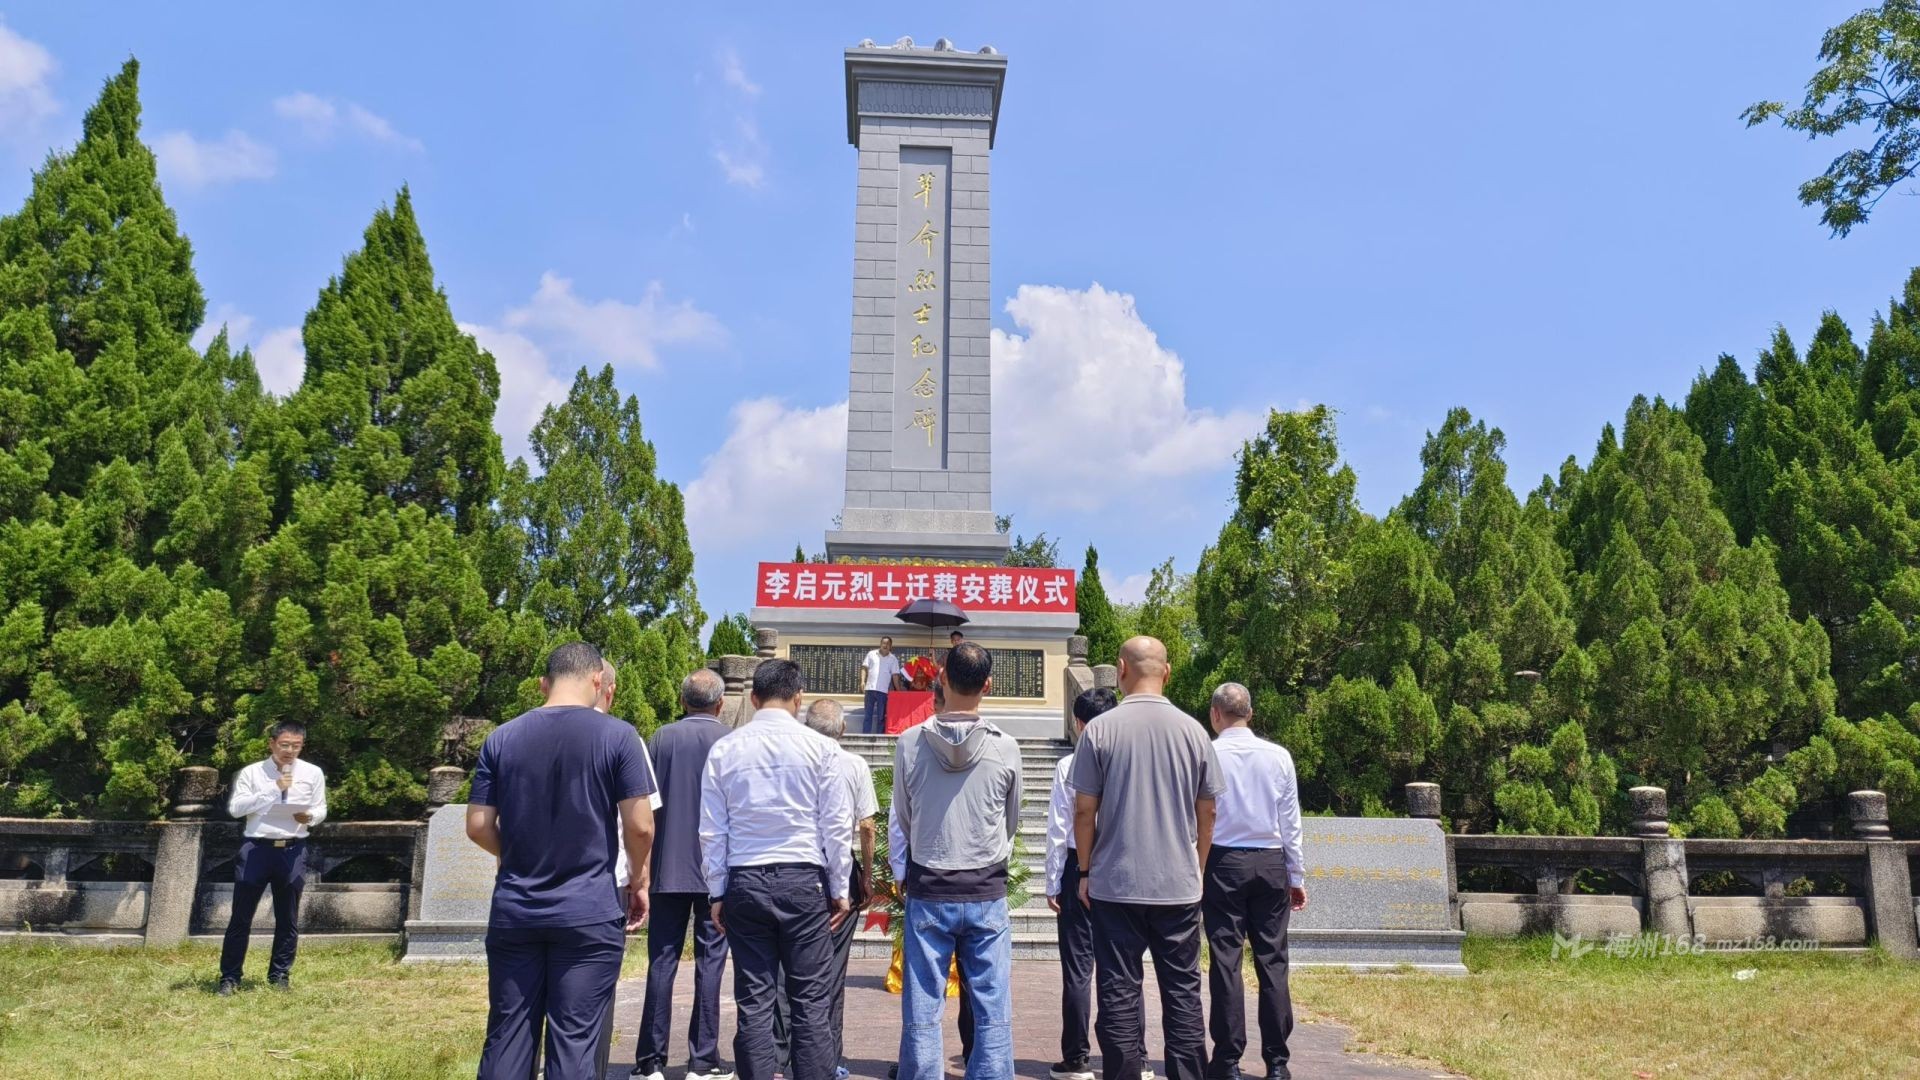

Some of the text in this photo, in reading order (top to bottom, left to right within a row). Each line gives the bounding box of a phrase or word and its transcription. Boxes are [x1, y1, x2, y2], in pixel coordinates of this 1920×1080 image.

[764, 568, 1069, 607] 李启元烈士迁葬安葬仪式
